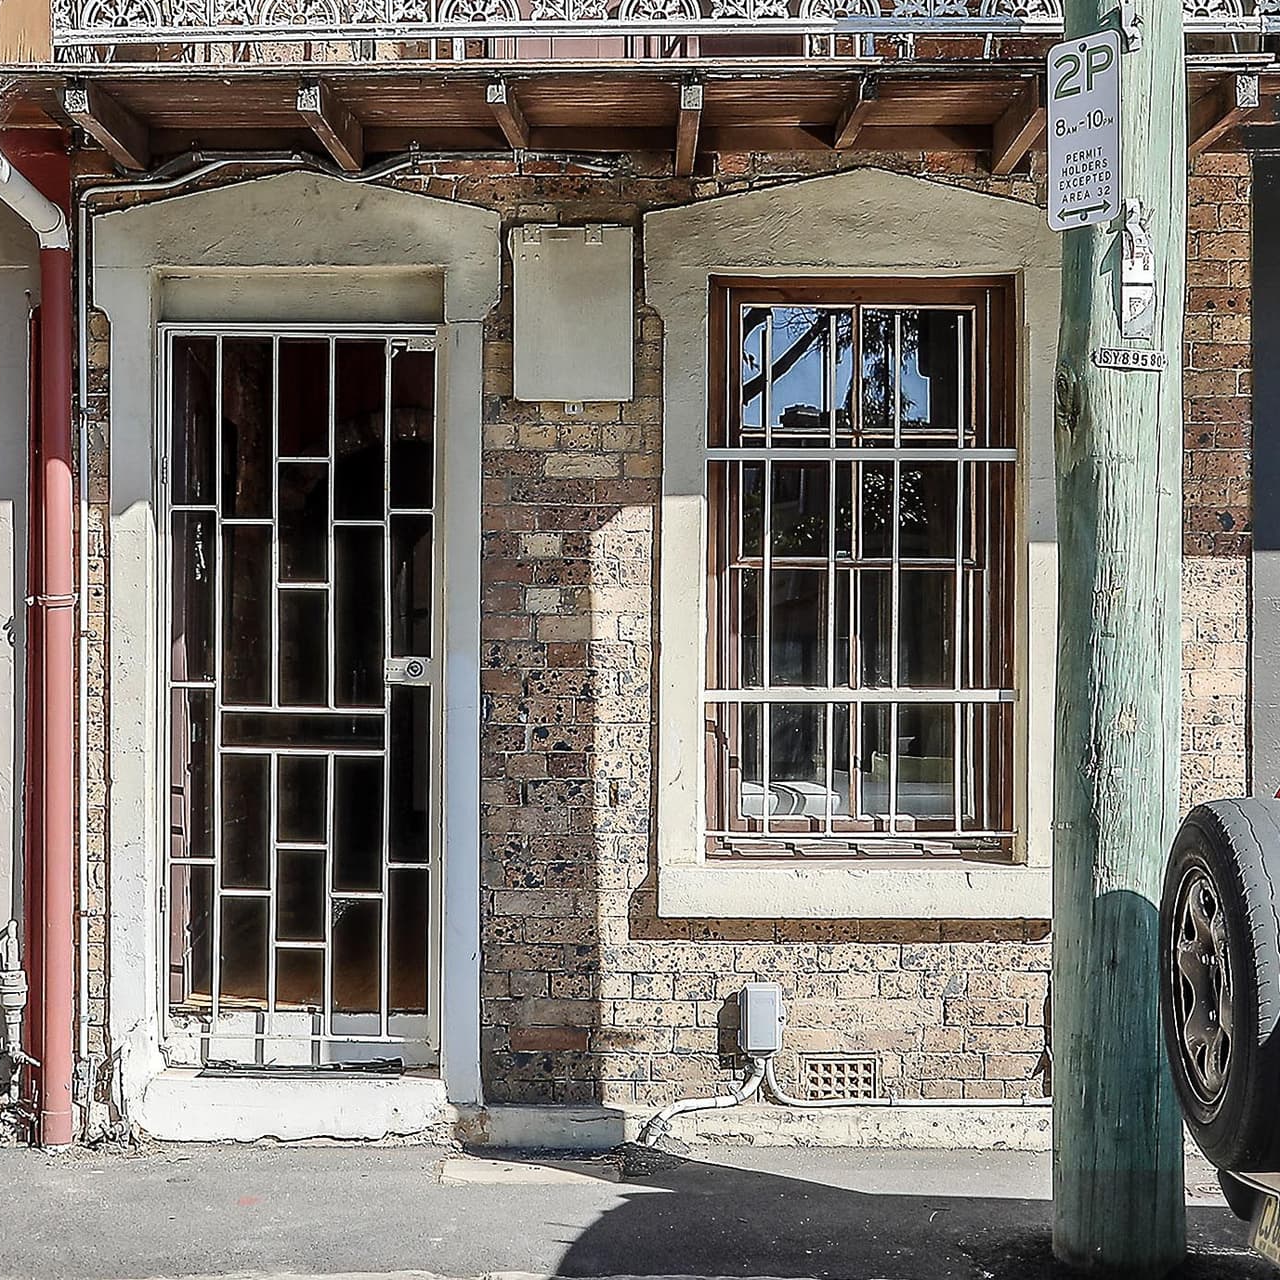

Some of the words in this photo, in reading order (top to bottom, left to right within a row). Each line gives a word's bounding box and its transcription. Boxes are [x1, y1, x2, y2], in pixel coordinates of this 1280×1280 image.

[1054, 44, 1113, 99] 2P
[1066, 146, 1102, 163] PERMIT
[1062, 158, 1108, 177] HOLDERS
[1059, 170, 1111, 191] EXCEPTED
[1062, 190, 1090, 204] AREA
[1097, 185, 1111, 197] 32
[1102, 350, 1162, 368] SY89580
